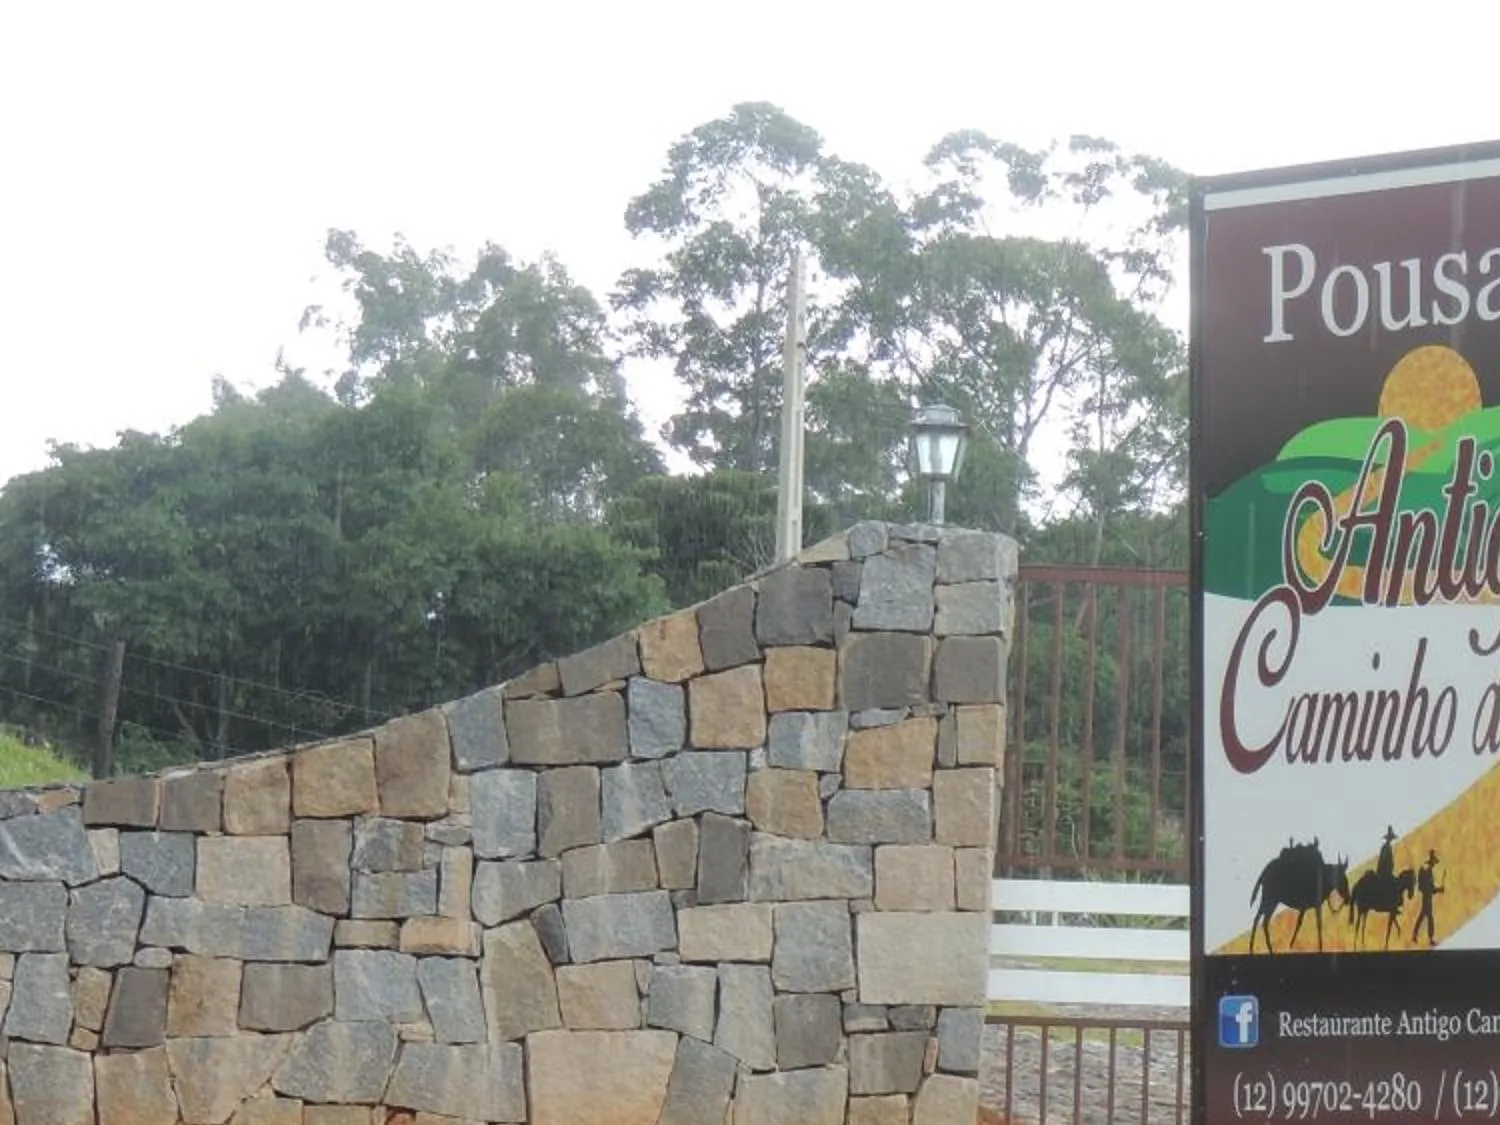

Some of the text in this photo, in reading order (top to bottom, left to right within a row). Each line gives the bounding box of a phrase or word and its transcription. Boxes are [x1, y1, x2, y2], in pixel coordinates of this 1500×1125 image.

[1220, 585, 1458, 774] Caminho
[1278, 1010, 1392, 1037] Restaurante
[1396, 1009, 1461, 1041] Antigo
[1232, 1071, 1277, 1119] (12)
[1282, 1072, 1422, 1119] 99702-4280
